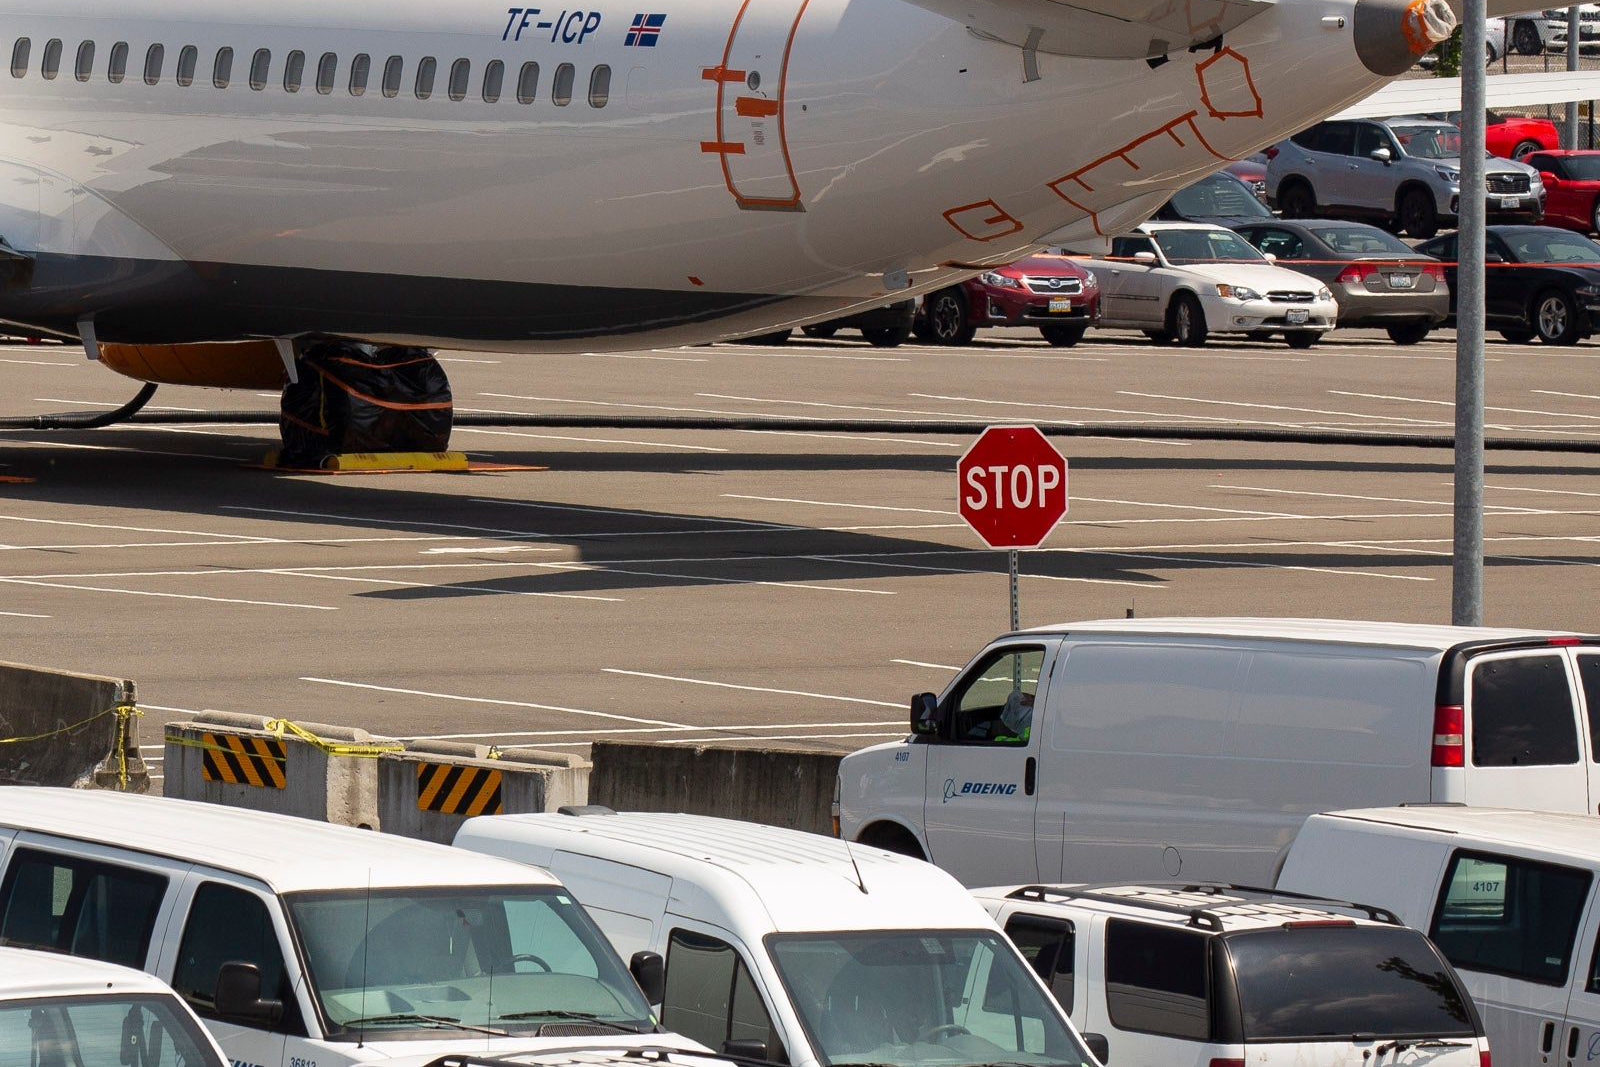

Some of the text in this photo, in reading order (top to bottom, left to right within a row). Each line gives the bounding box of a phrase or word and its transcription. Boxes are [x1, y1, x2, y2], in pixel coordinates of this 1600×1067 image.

[501, 7, 602, 45] TF-ICP
[965, 463, 1060, 511] STOP
[895, 752, 910, 762] 4107
[960, 782, 1018, 795] BOEING
[1472, 881, 1500, 892] 4107
